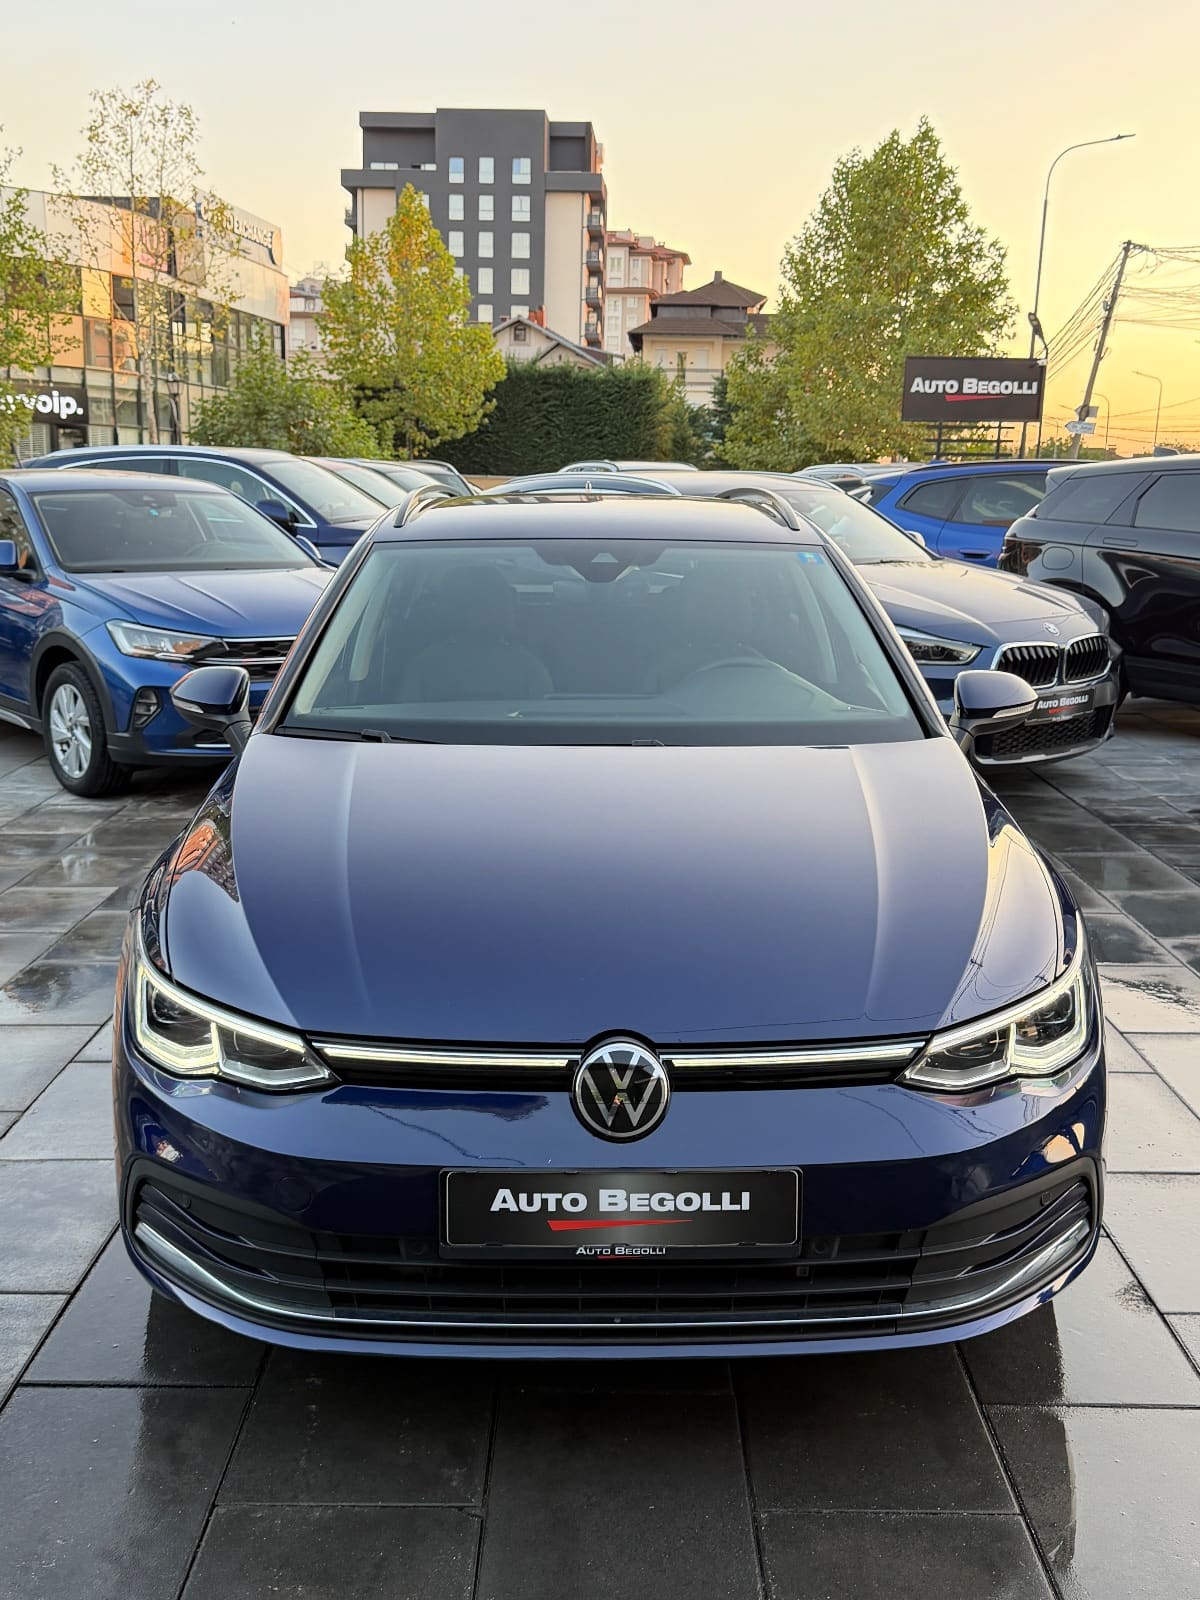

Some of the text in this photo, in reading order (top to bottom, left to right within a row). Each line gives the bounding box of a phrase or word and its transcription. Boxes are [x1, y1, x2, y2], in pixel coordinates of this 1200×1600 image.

[910, 376, 1038, 394] AUTO BEGOLLI
[1037, 699, 1059, 710] AUTO
[490, 1188, 751, 1212] AUTO BEGOLLI
[576, 1246, 666, 1256] AUTO BEGOLLI
